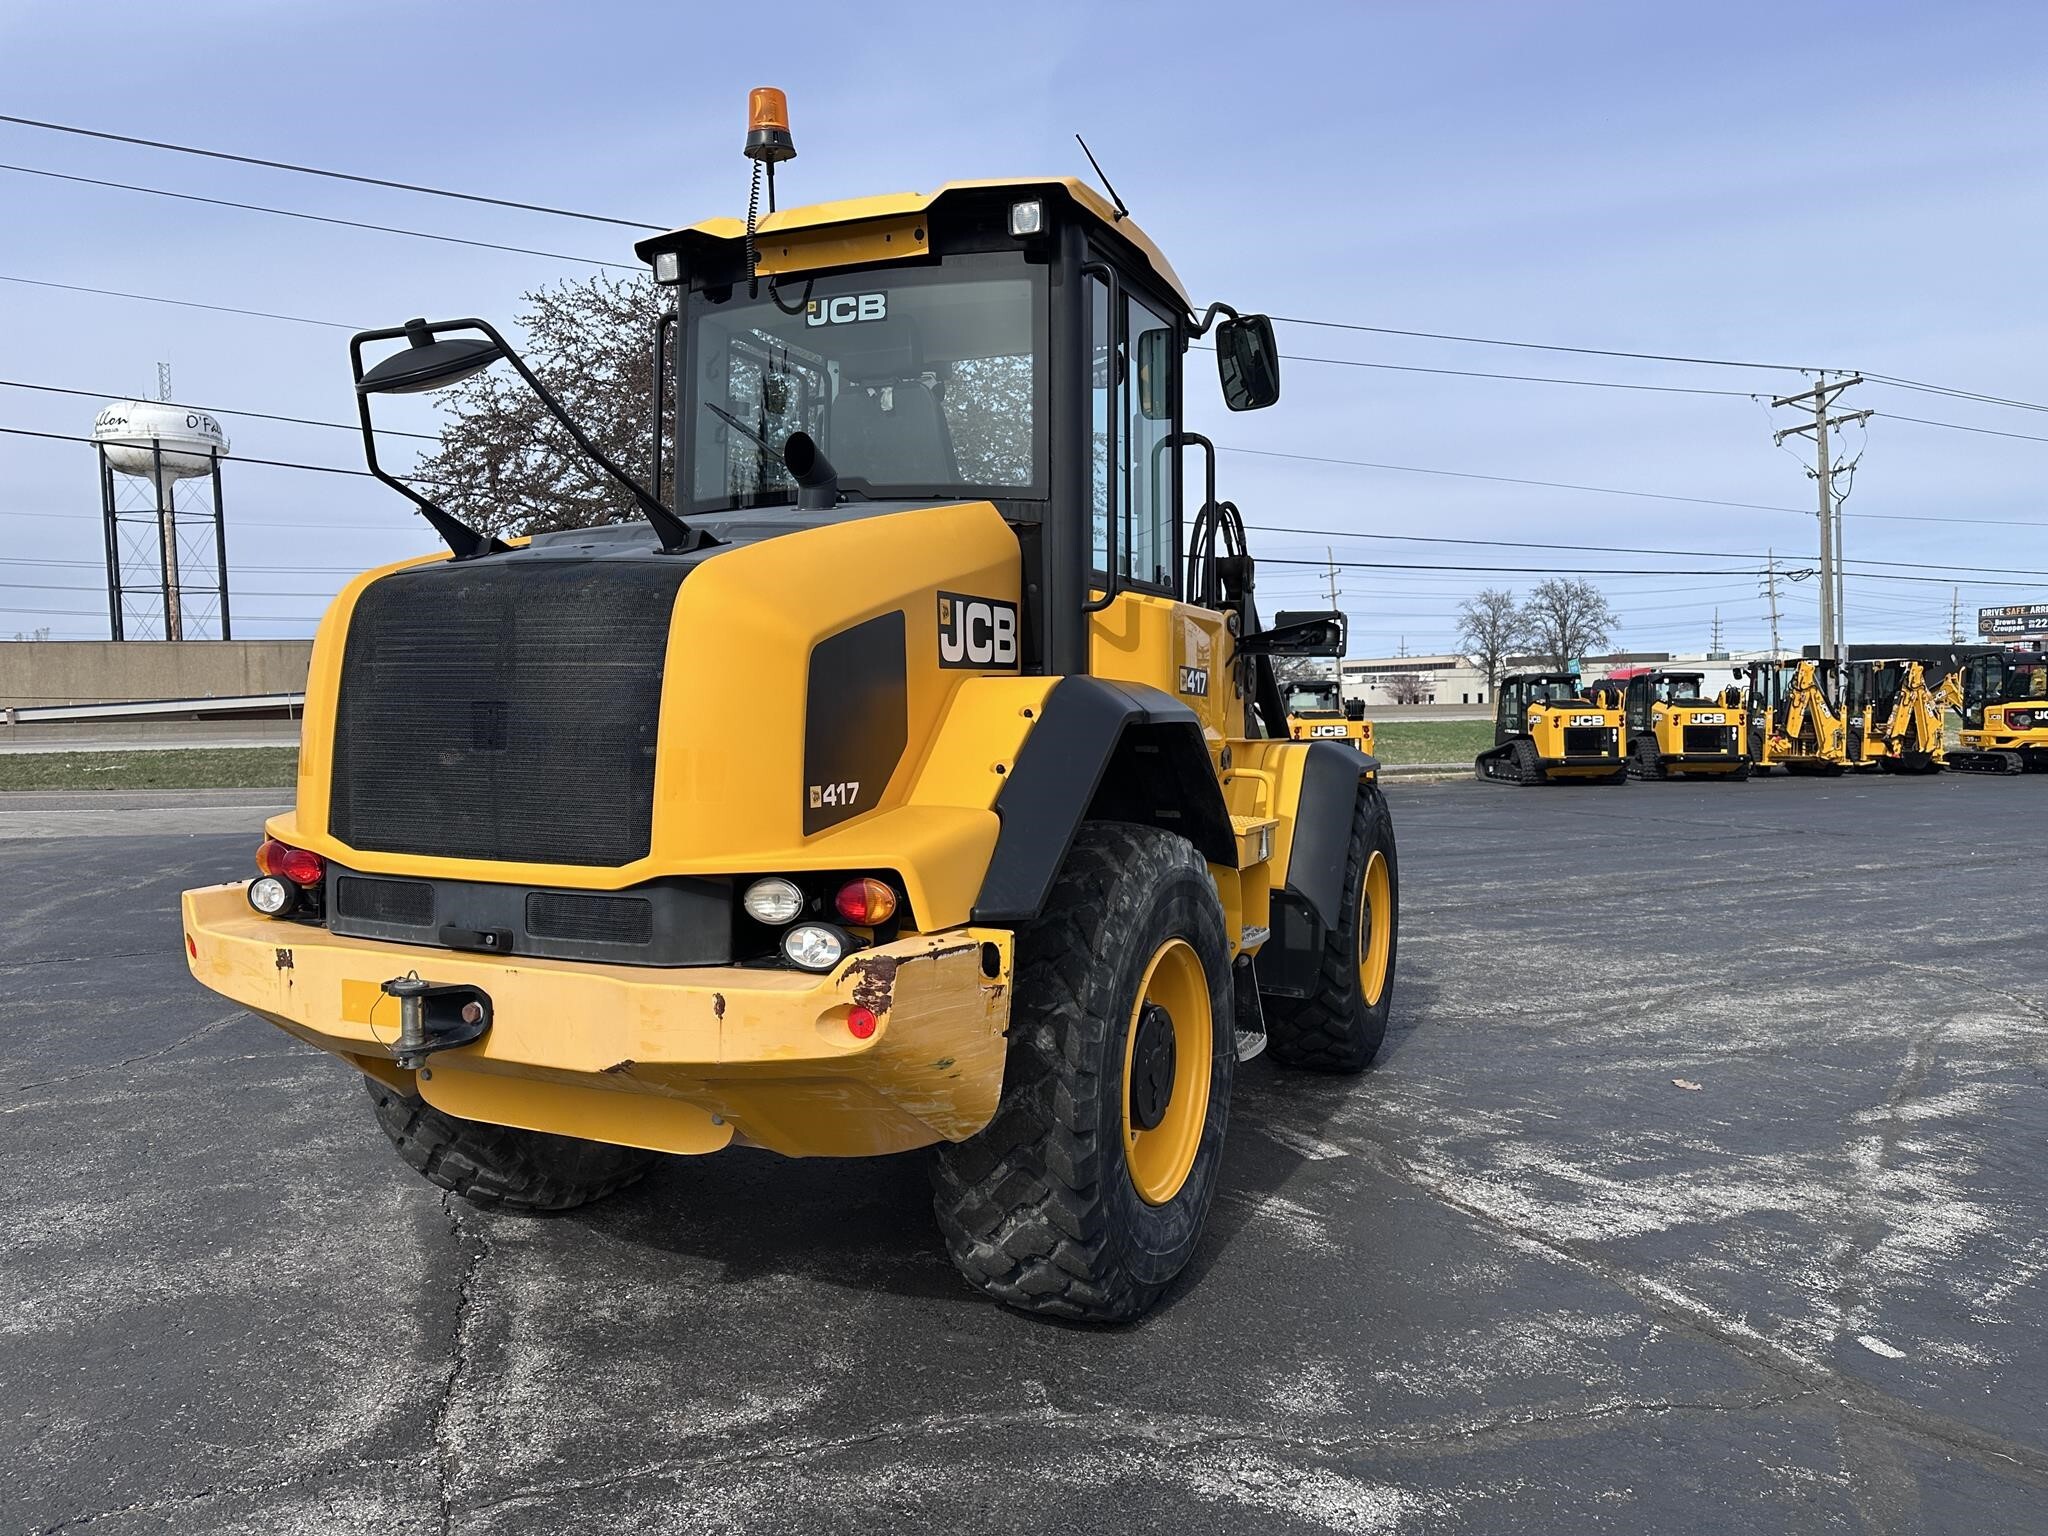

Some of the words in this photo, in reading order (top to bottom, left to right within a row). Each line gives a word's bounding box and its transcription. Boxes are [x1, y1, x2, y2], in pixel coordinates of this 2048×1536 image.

[807, 293, 886, 327] JCB
[1981, 608, 2004, 617] DRIVE
[941, 600, 1017, 663] JCB
[1187, 669, 1207, 694] 417
[1570, 715, 1604, 726] JCB
[1691, 713, 1726, 723] JCB
[1311, 726, 1347, 737] JCB
[822, 782, 860, 807] 417
